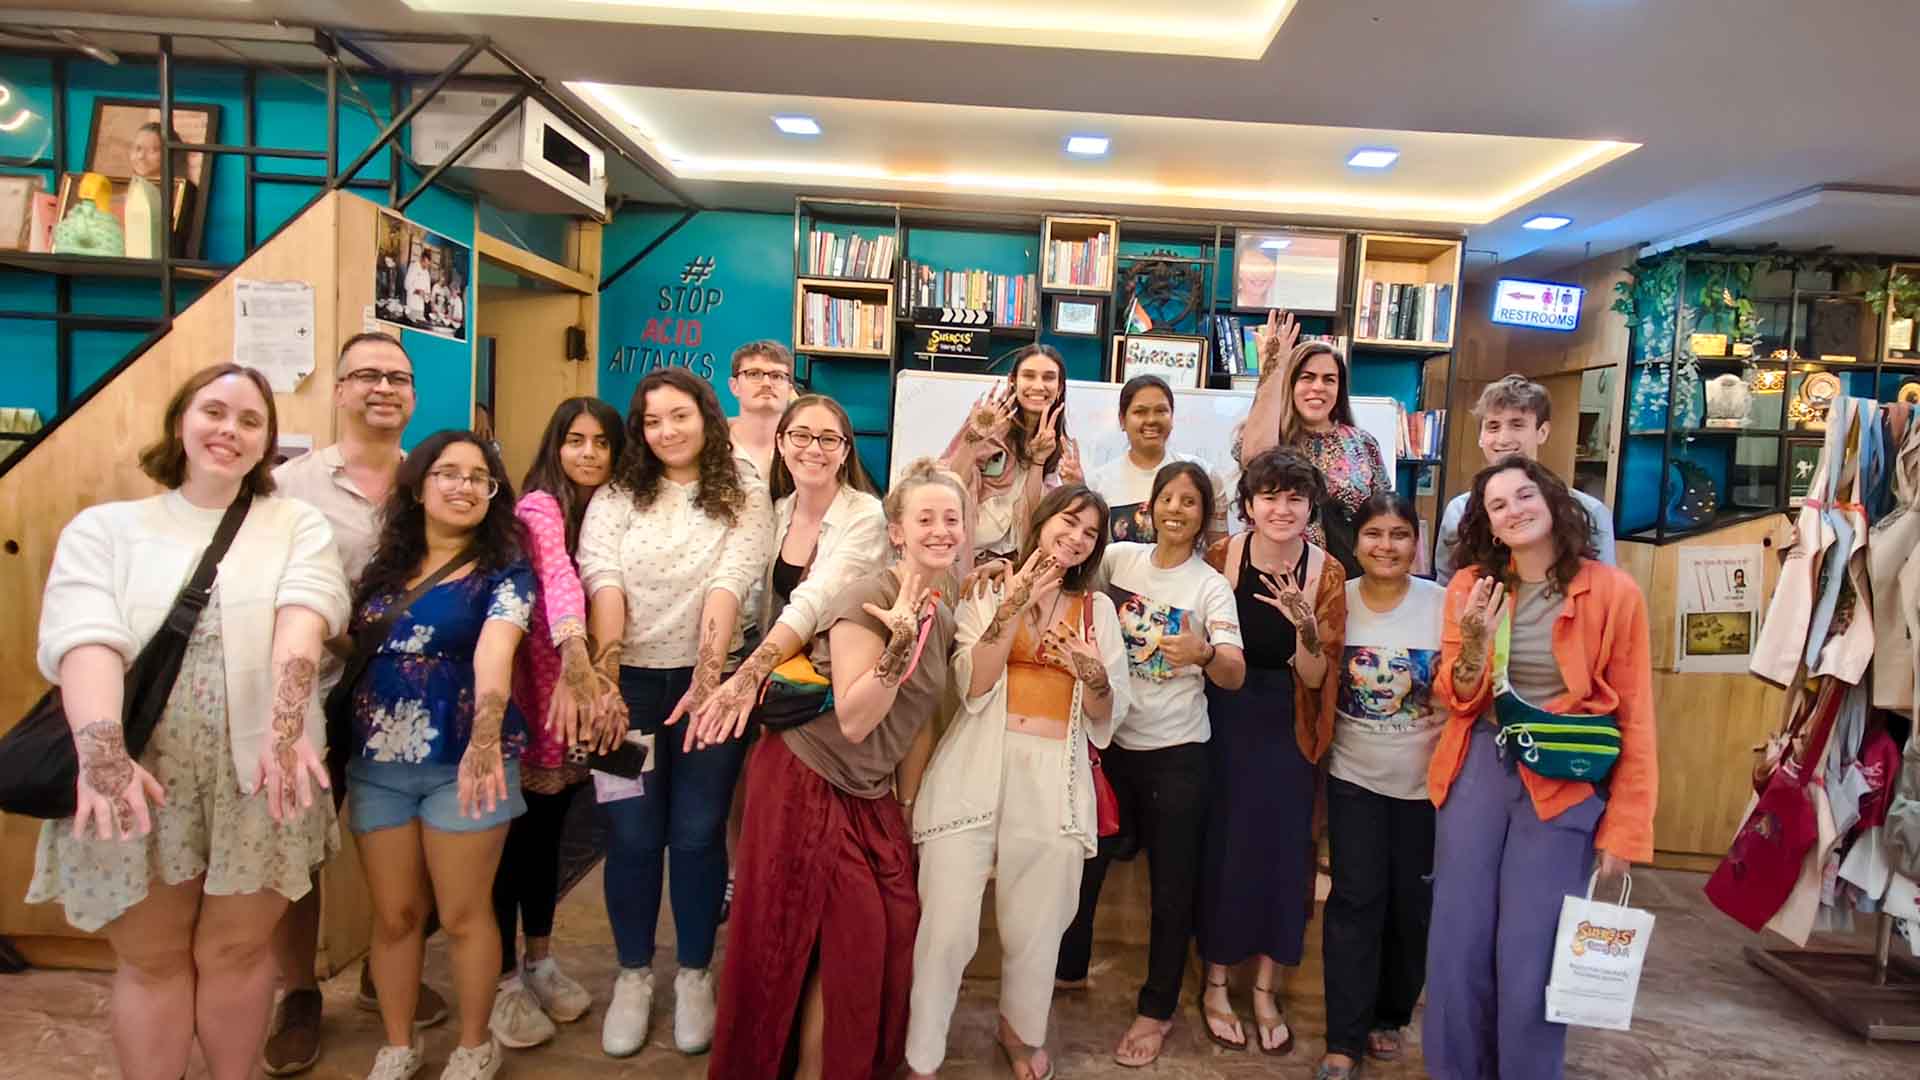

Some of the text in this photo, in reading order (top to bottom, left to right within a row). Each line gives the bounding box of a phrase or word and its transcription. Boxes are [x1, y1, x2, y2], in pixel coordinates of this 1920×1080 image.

[680, 255, 717, 286] #
[658, 285, 725, 315] STOP
[641, 317, 703, 347] ACID
[1500, 307, 1576, 327] RESTROOMS
[608, 345, 717, 381] ATTACKS
